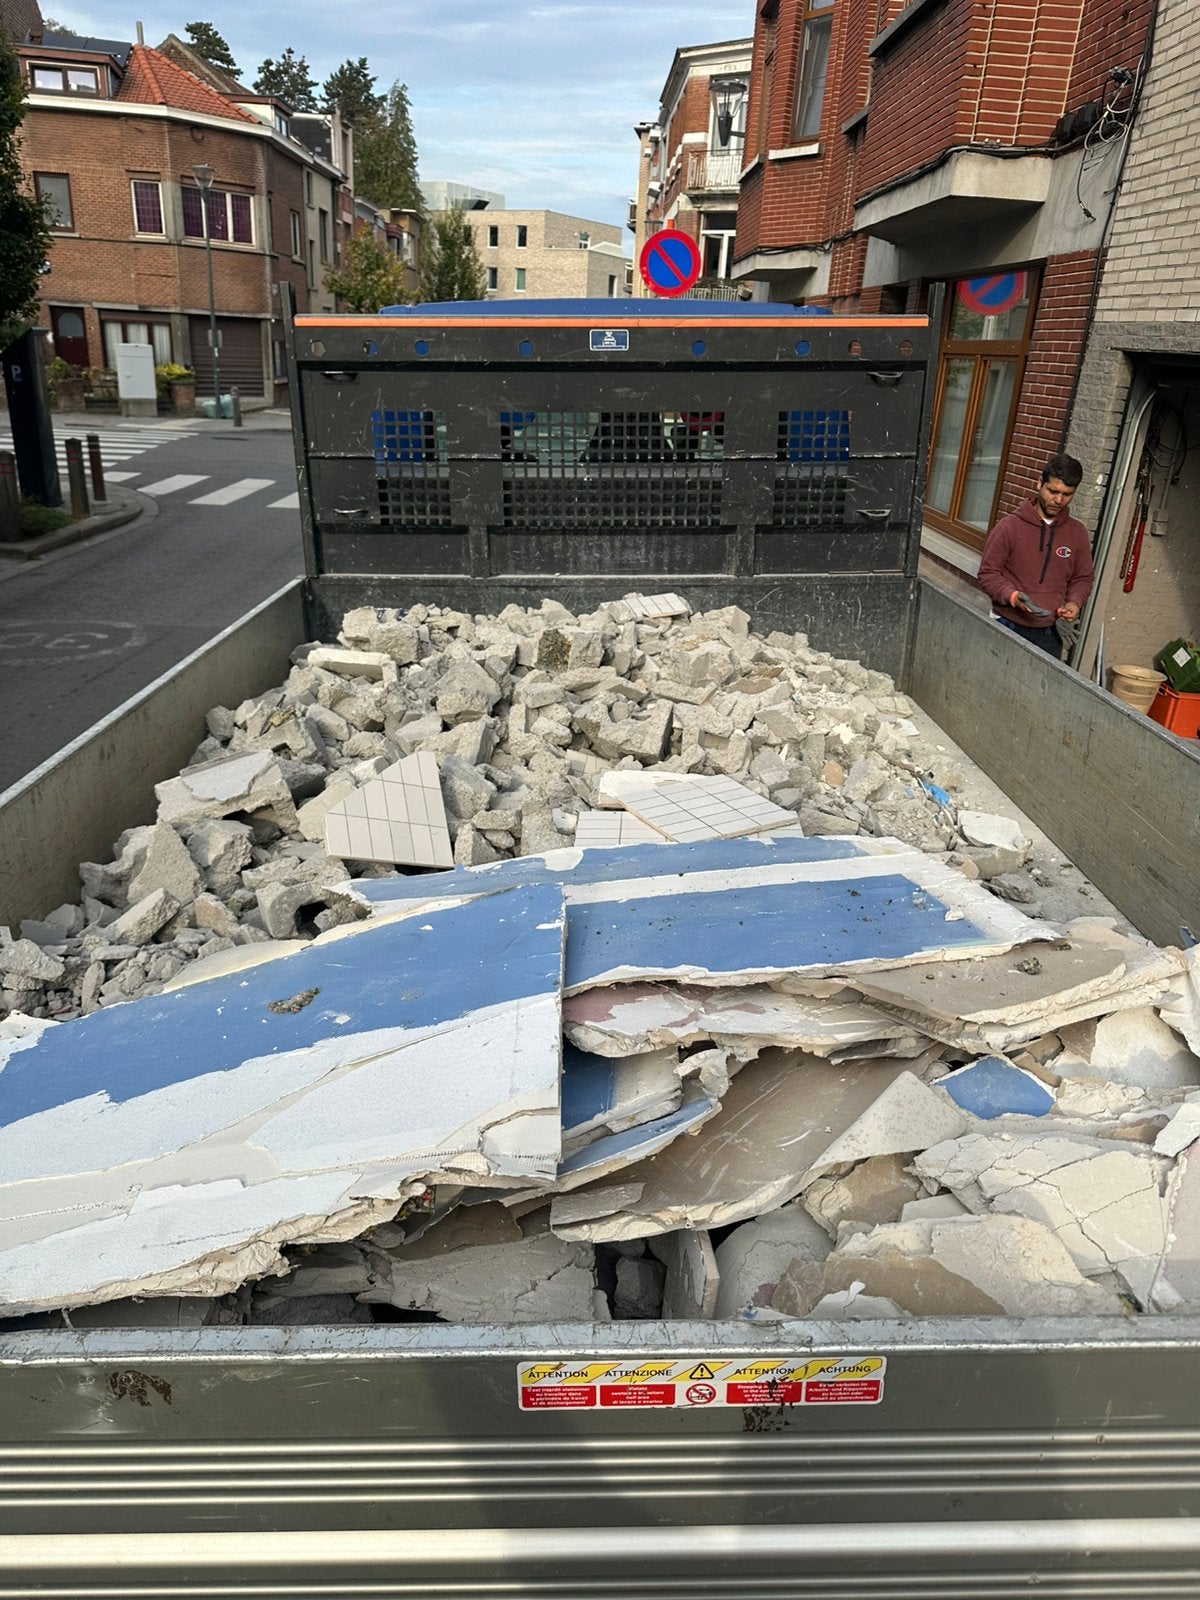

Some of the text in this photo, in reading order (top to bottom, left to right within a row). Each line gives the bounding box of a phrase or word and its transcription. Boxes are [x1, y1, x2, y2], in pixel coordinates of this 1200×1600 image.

[10, 365, 21, 378] P
[604, 1369, 673, 1378] ATTENZIONE
[734, 1367, 795, 1375] ATTENTION
[818, 1365, 872, 1374] ACHTUNG
